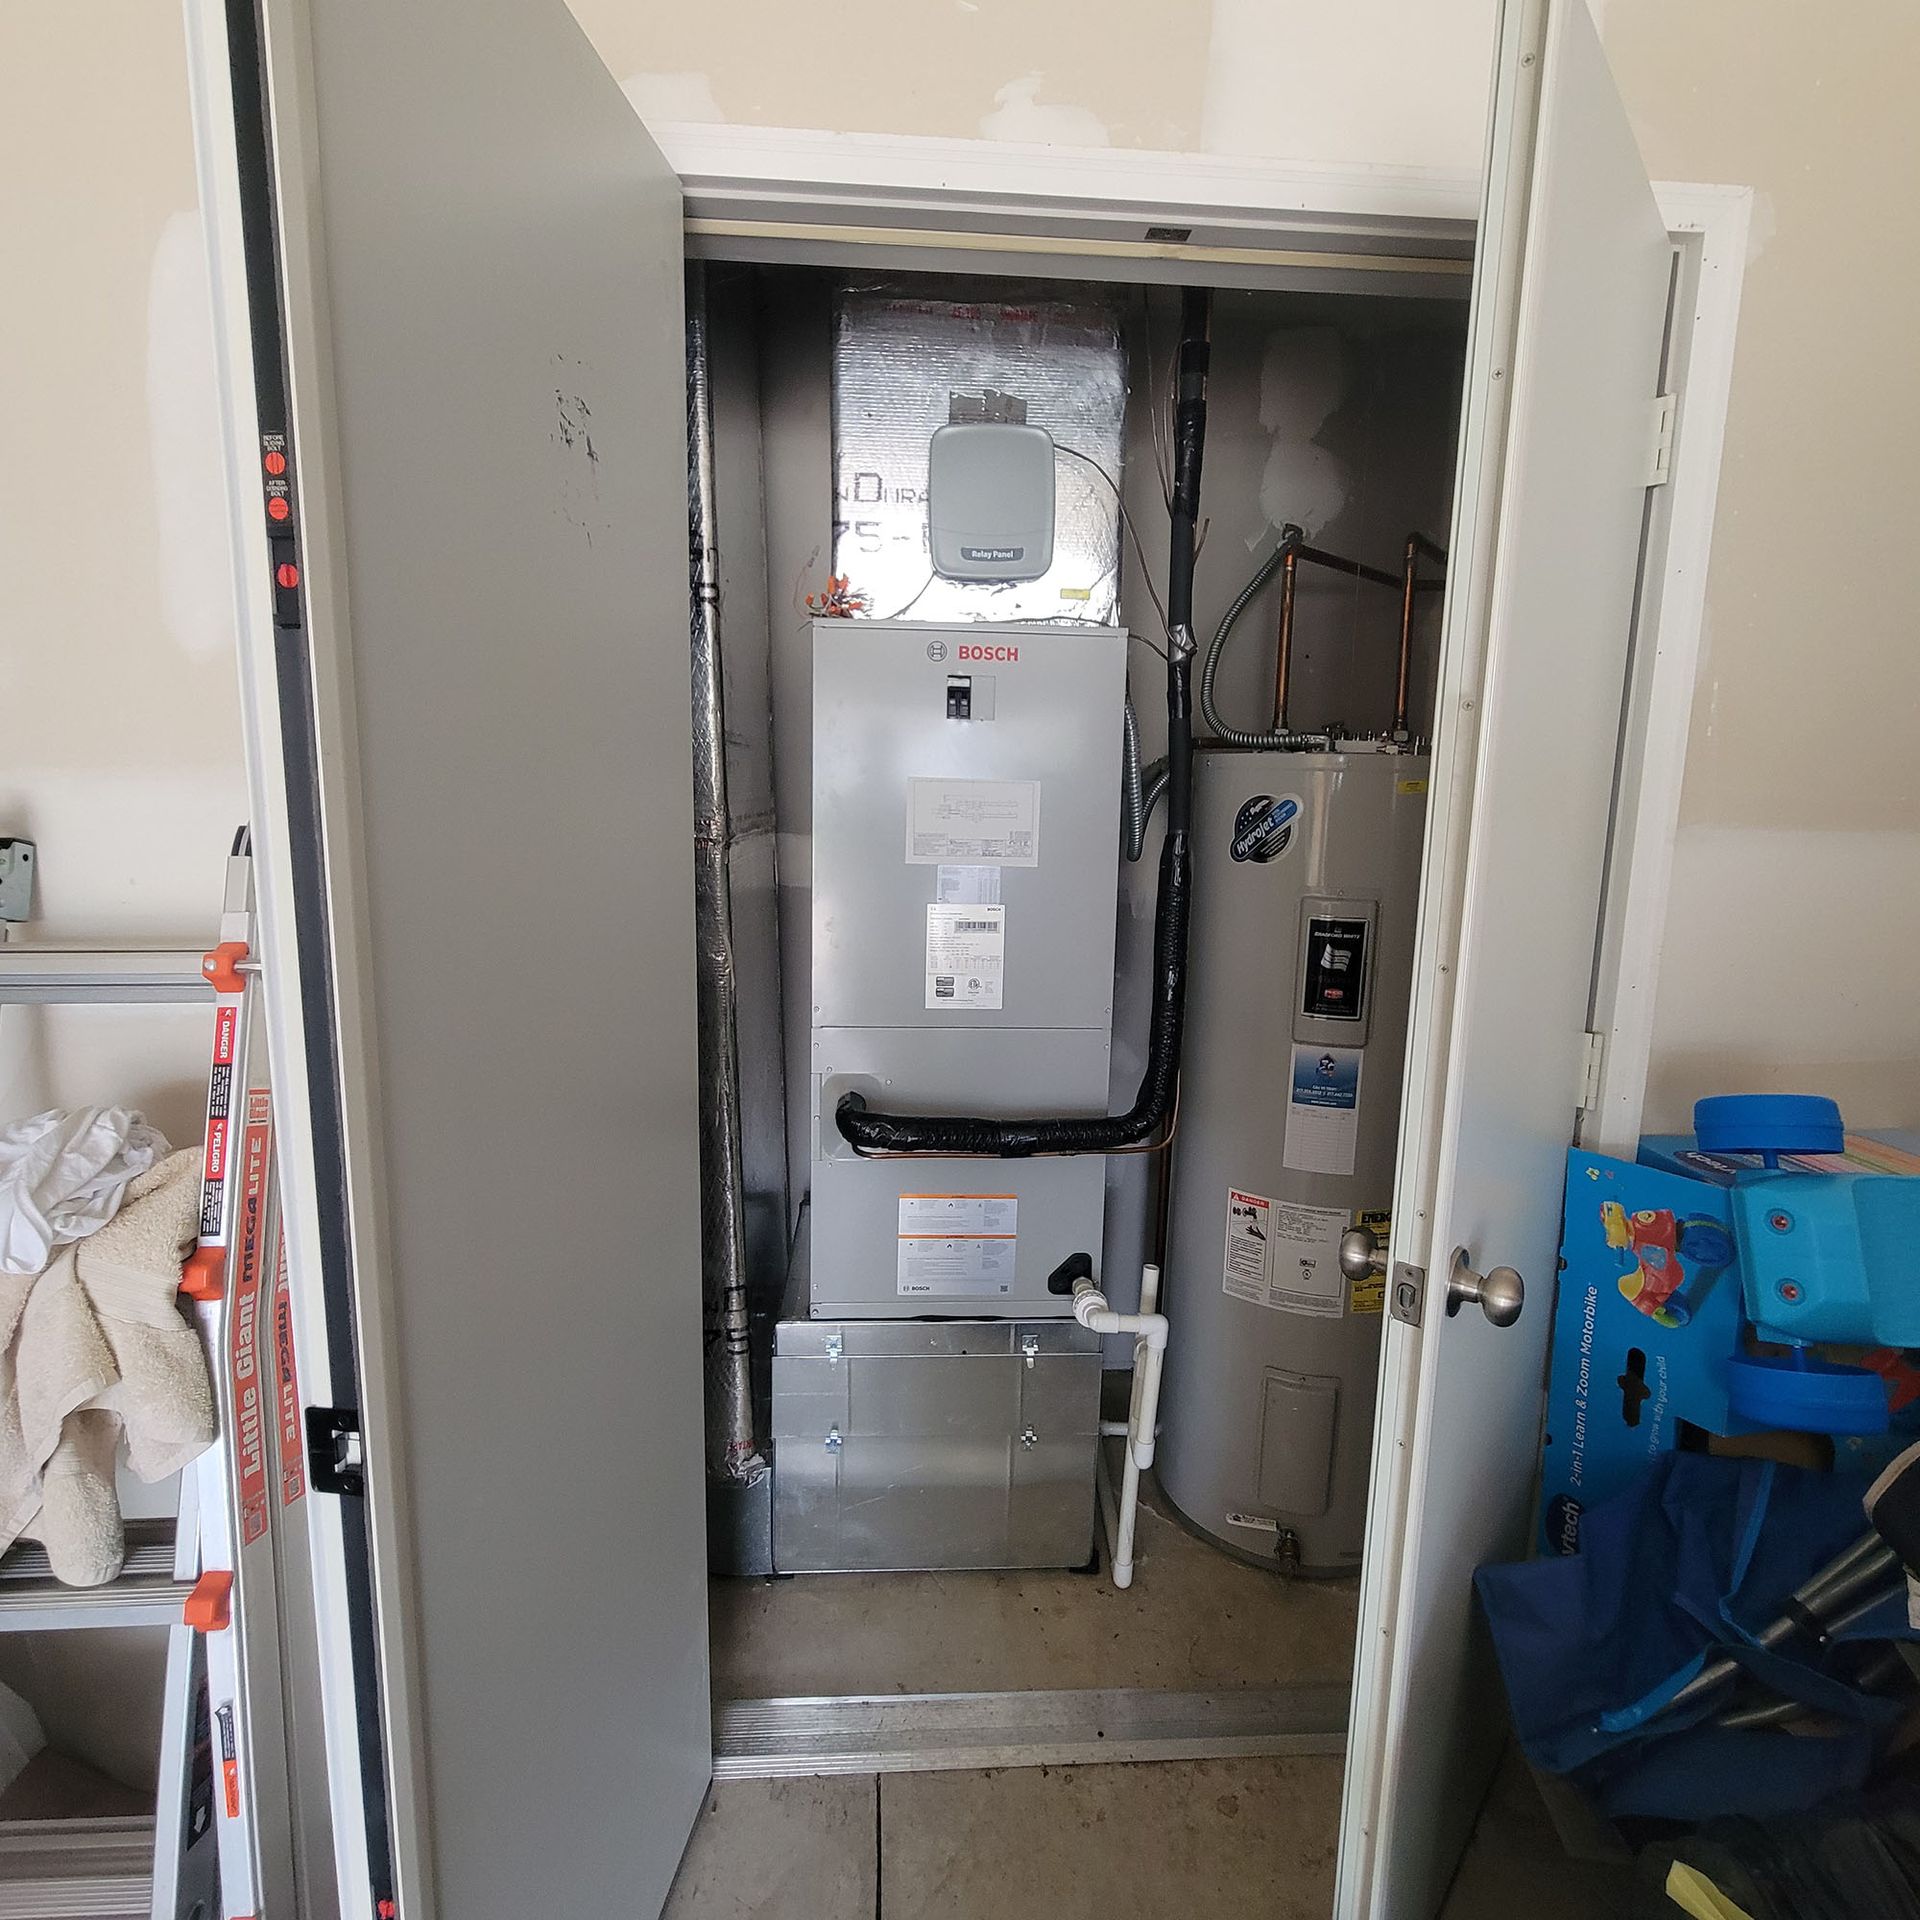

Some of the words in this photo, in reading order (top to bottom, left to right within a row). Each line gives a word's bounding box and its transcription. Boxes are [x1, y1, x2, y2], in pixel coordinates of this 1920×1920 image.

[971, 550, 992, 560] Relay
[993, 550, 1014, 558] Panel
[958, 645, 1019, 662] BOSCH
[219, 1020, 230, 1059] DANGER
[210, 1131, 222, 1173] PELIGRO
[236, 1291, 255, 1381] Giant
[1580, 1285, 1598, 1355] Motorbike
[1576, 1357, 1591, 1397] Zoom
[1656, 1355, 1668, 1379] child
[1575, 1399, 1587, 1410] &
[1659, 1379, 1669, 1403] your
[240, 1386, 260, 1480] Little
[1572, 1411, 1586, 1449] Learn
[1569, 1449, 1584, 1487] 2-in-1
[1561, 1500, 1580, 1555] vtech
